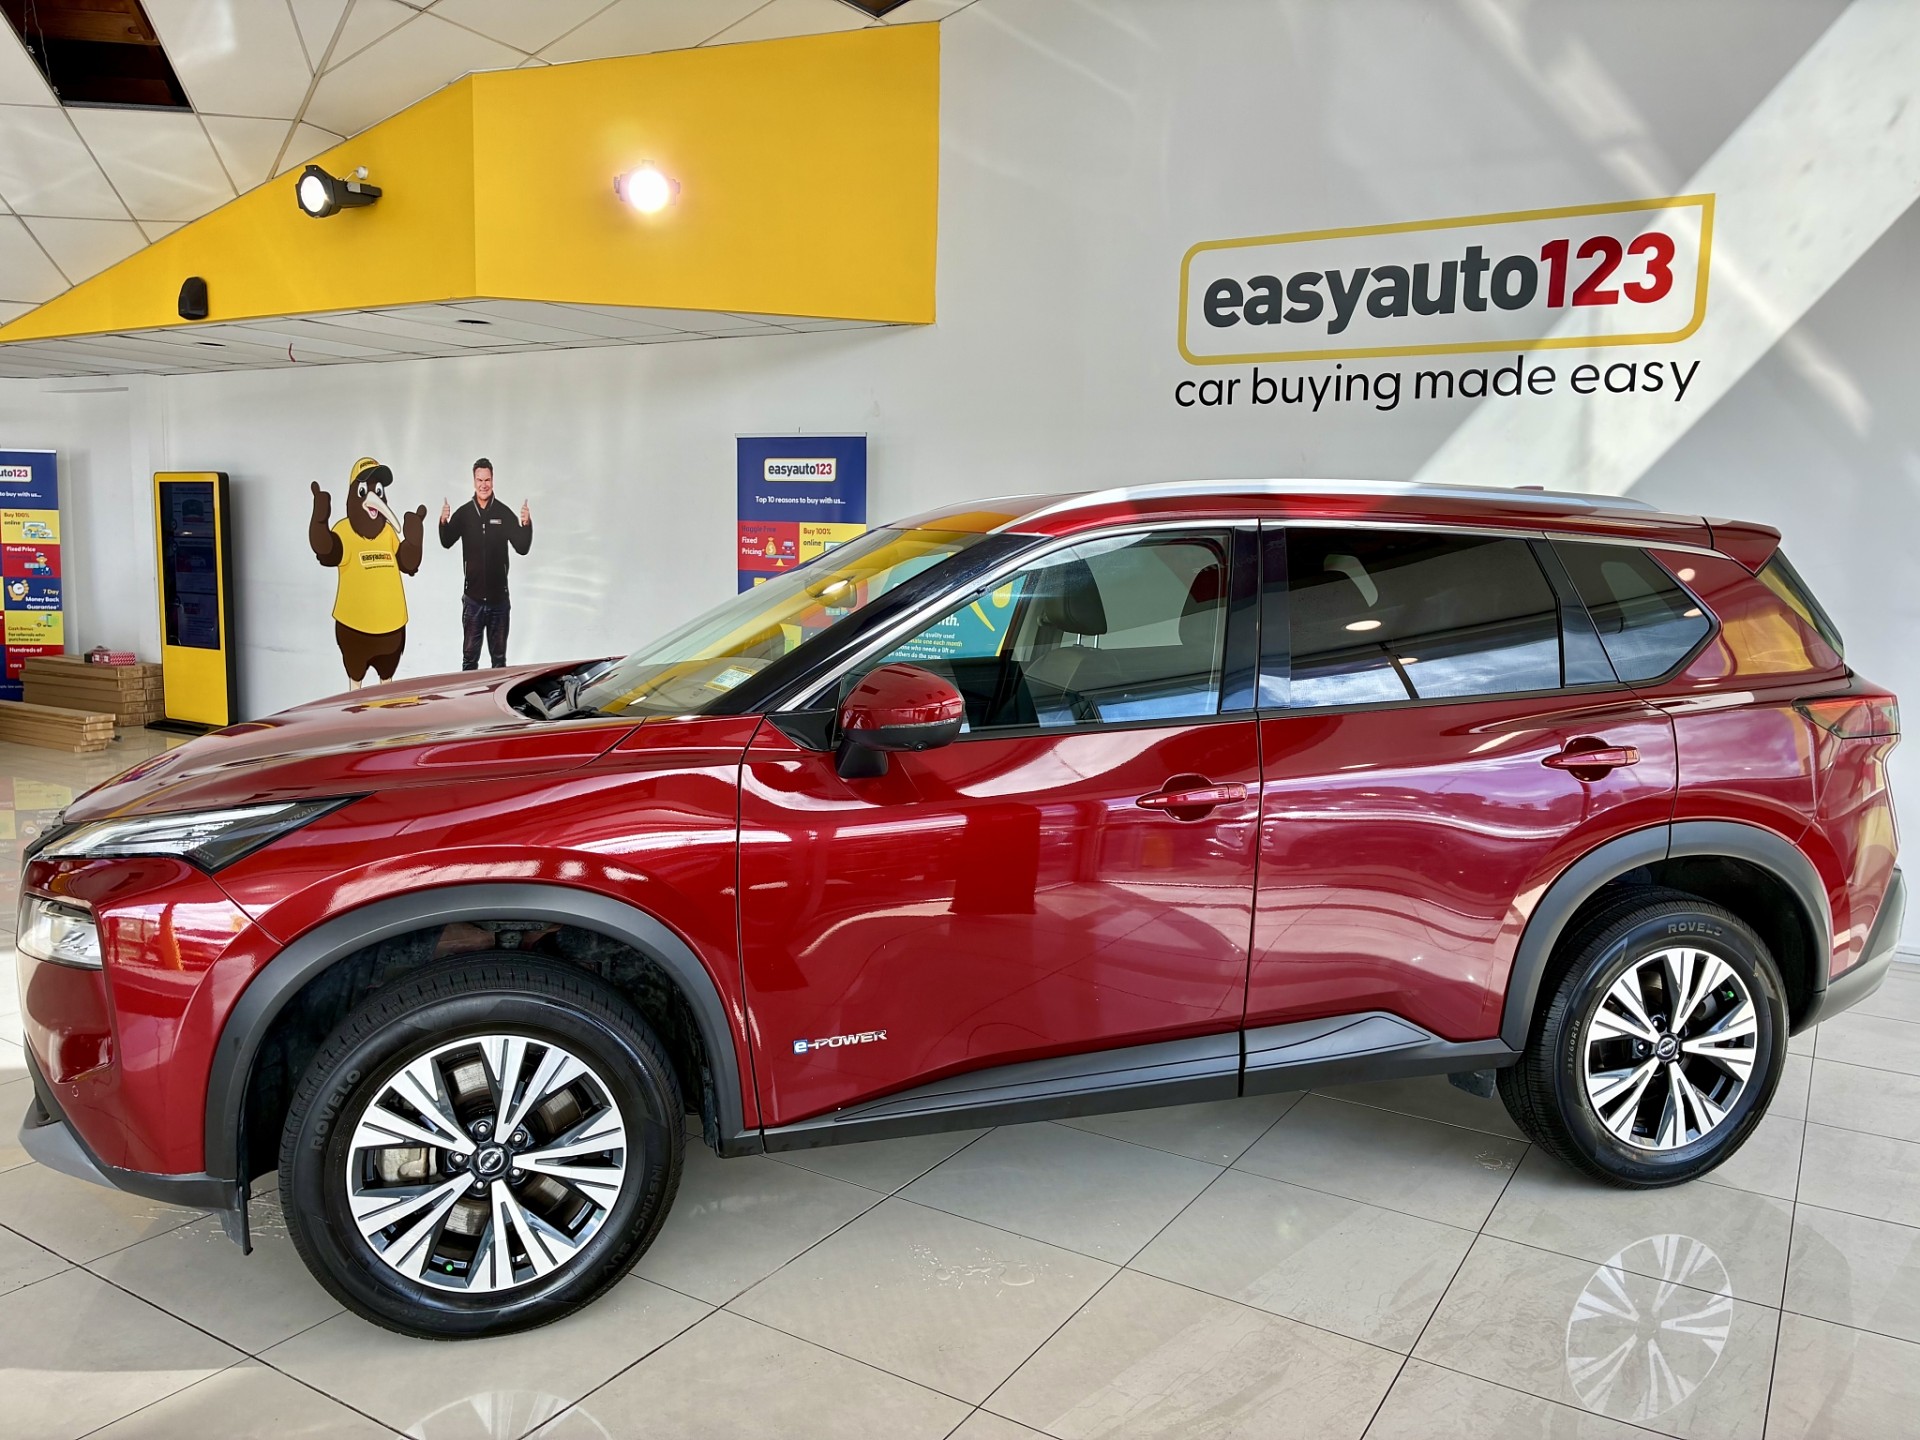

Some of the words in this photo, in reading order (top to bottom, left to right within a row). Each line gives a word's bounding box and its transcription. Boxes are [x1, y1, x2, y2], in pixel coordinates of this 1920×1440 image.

[1203, 231, 1677, 335] easyauto123
[1174, 378, 1241, 407] car
[1251, 363, 1401, 412] buying
[1414, 354, 1557, 400] made
[1570, 360, 1700, 402] easy
[768, 463, 832, 477] easyauto123
[755, 495, 767, 504] Top
[807, 497, 818, 506] buy
[742, 536, 758, 544] Fixed
[793, 1029, 888, 1054] e-POWER
[310, 1069, 361, 1151] ROVELO
